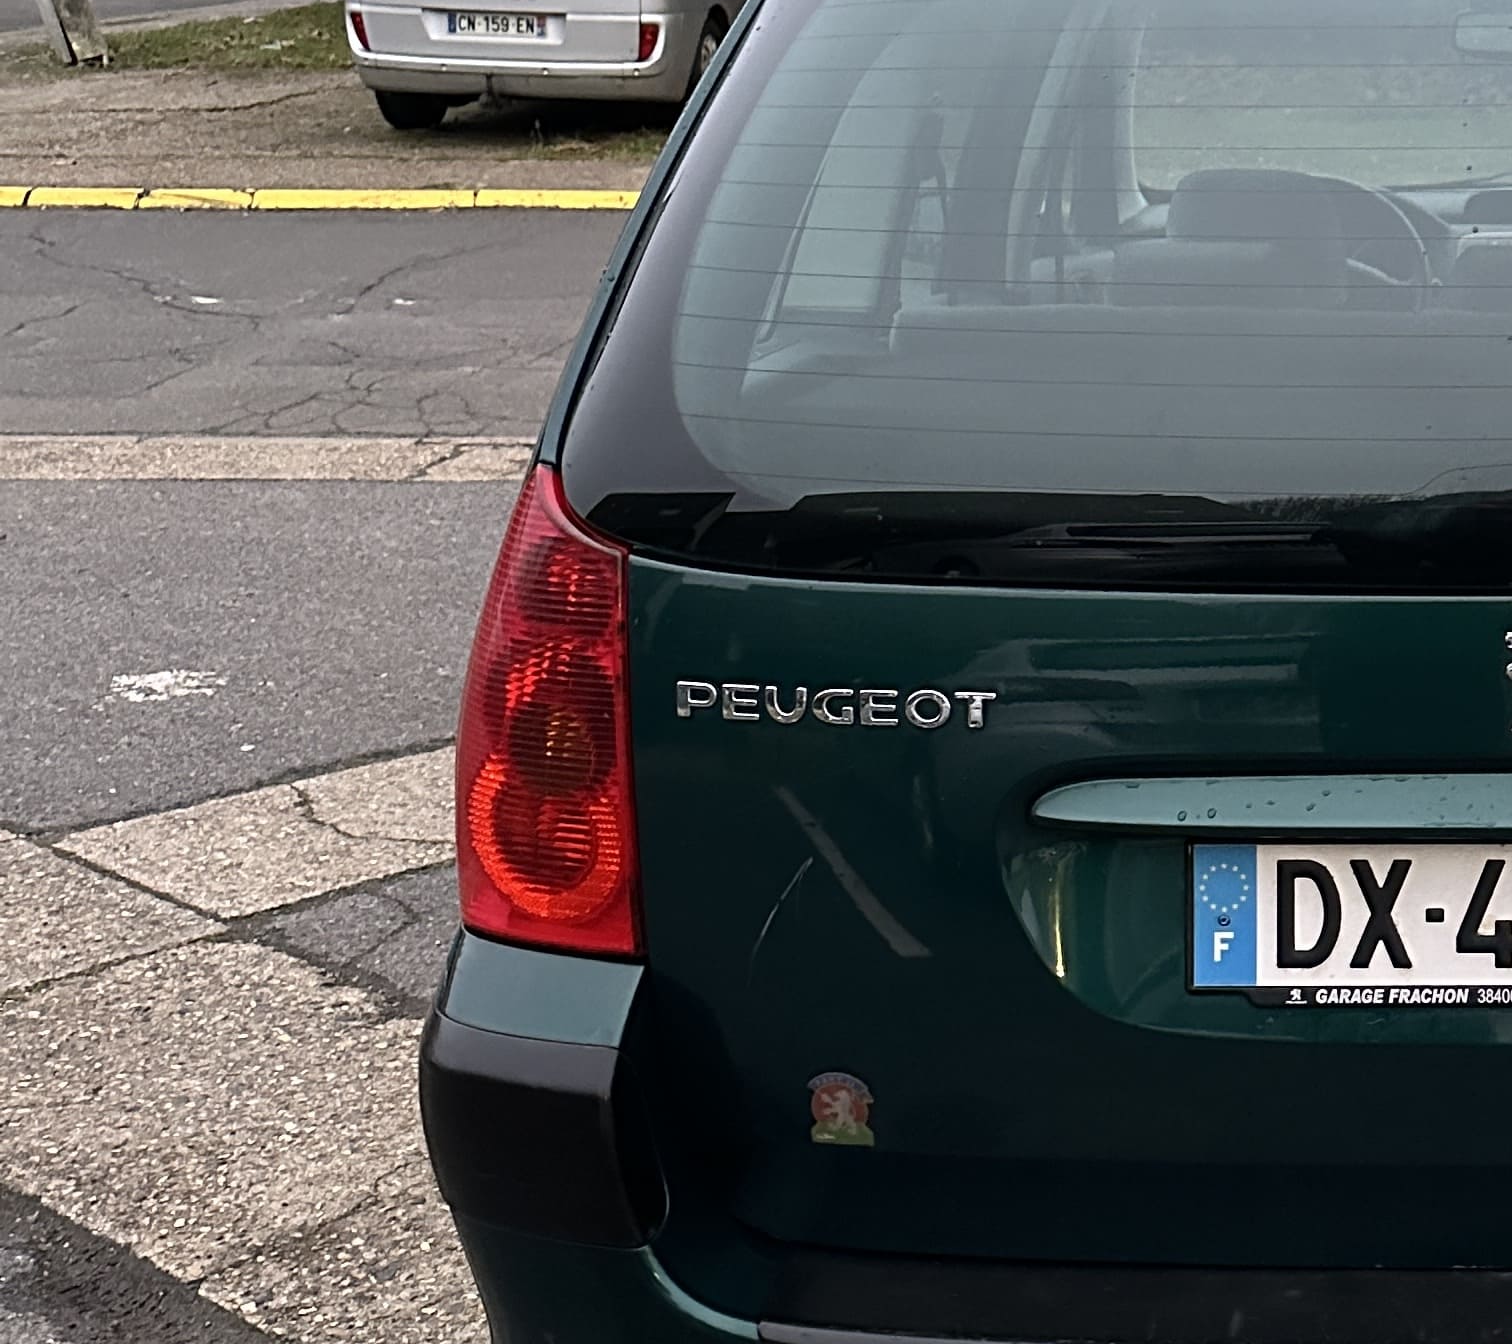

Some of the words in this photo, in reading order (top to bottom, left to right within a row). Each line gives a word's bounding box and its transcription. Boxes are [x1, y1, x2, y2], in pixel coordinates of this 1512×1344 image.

[676, 680, 997, 729] PEUGEOT
[1213, 931, 1235, 962] F
[1315, 988, 1385, 1004] GARAGE
[1388, 988, 1470, 1004] FRACHON
